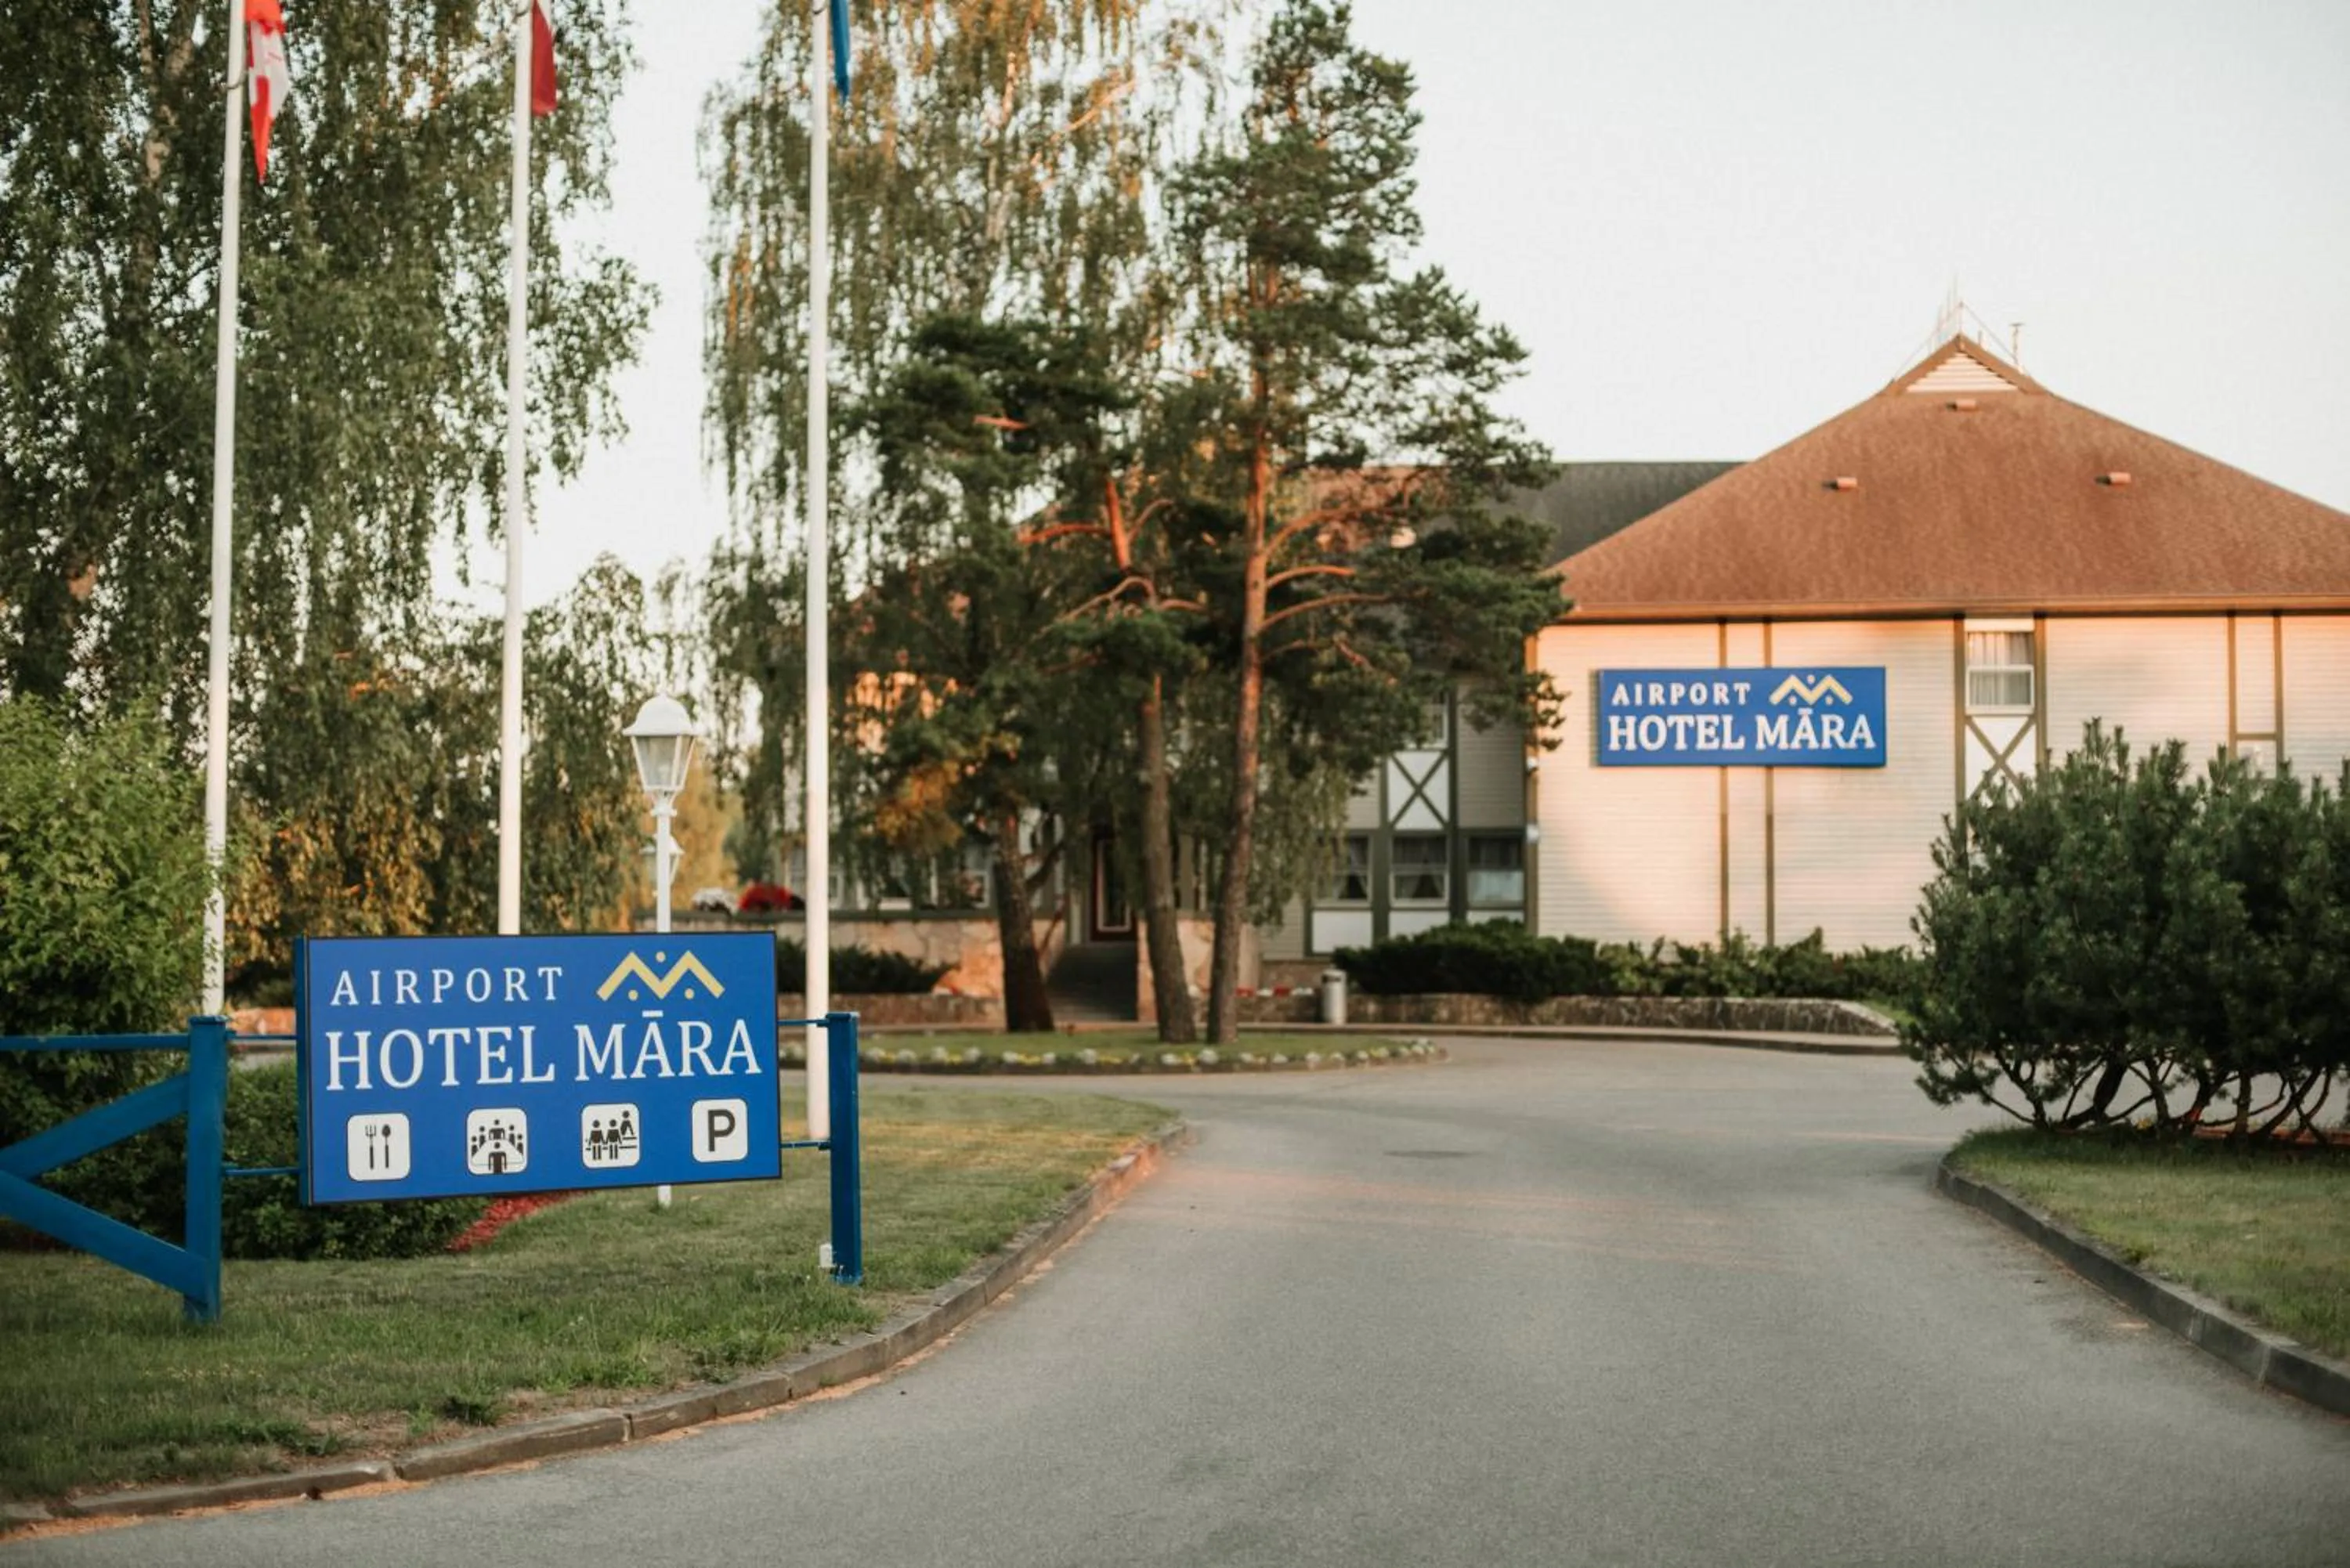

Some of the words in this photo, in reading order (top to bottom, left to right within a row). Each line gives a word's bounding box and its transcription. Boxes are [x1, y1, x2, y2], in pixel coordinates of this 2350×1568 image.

[1611, 682, 1751, 706] AIRPORT
[1608, 714, 1745, 751] HOTEL
[1755, 707, 1876, 750] MĀRA
[330, 966, 562, 1006] AIRPORT
[325, 1025, 555, 1091] HOTEL
[574, 1010, 762, 1082] MĀRA
[707, 1109, 736, 1152] P
